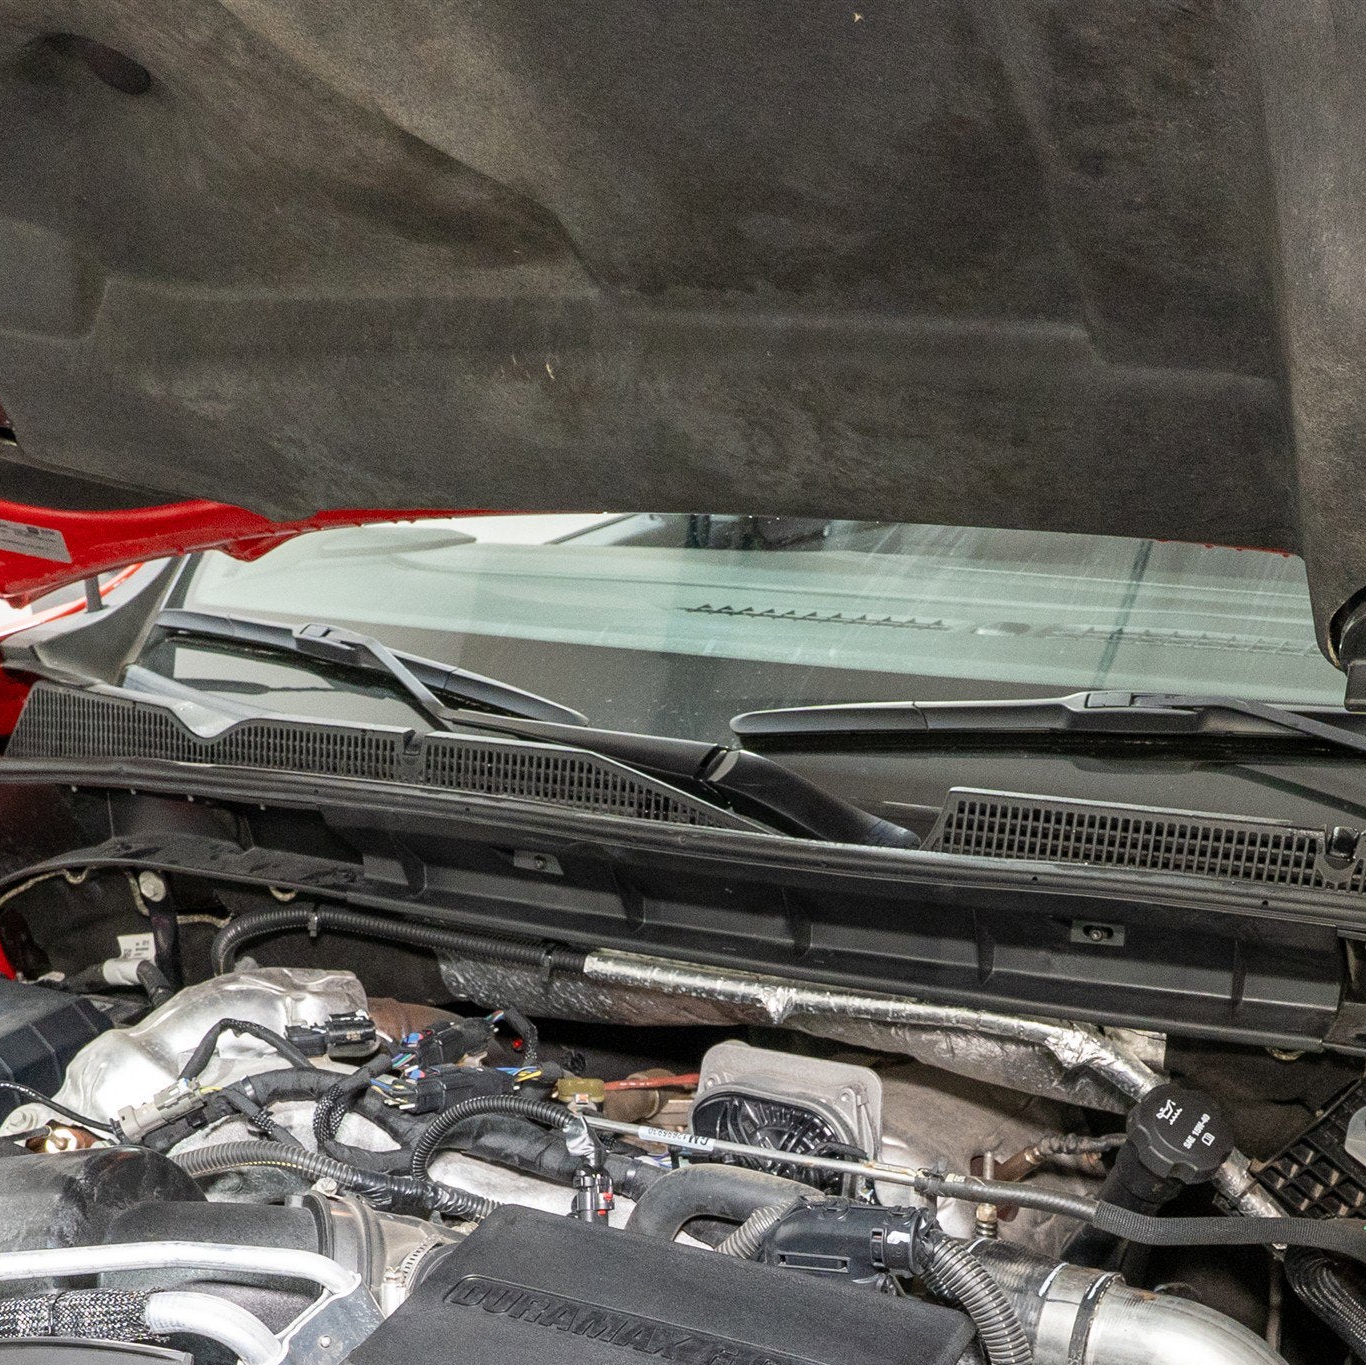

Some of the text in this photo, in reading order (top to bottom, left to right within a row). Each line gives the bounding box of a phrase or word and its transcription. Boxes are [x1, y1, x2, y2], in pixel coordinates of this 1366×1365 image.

[1183, 1113, 1211, 1150] SAE 15W-40
[450, 1283, 691, 1360] DURAMAX
